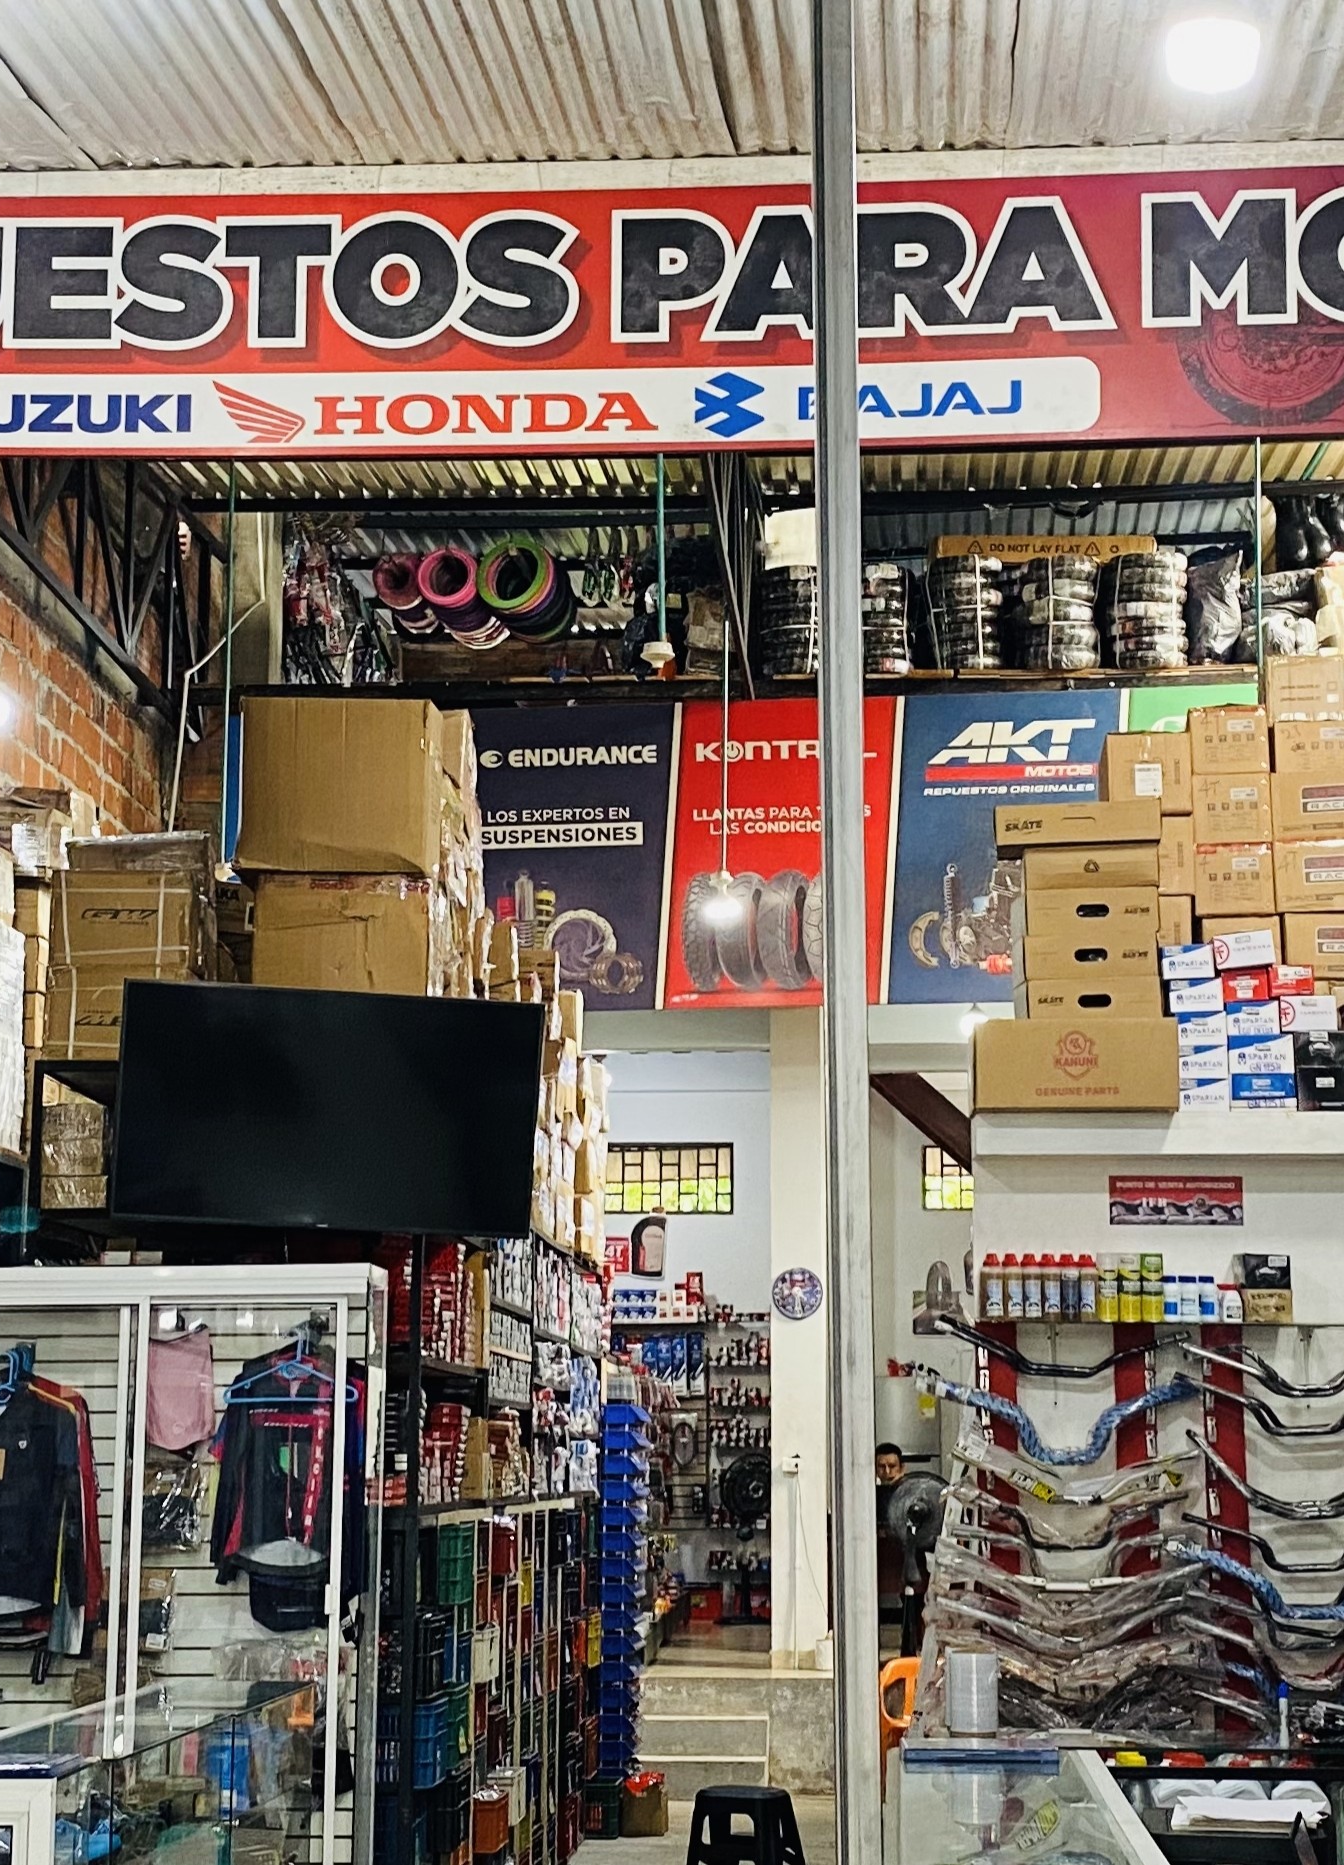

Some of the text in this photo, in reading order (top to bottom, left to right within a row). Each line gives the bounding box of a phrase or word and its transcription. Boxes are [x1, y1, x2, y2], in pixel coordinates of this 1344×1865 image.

[612, 195, 1116, 344] PARA
[314, 391, 658, 436] HONDA
[989, 543, 1081, 555] DO NOT LAY FLAT
[928, 718, 1096, 765] AKT
[508, 744, 658, 768] ENDURANCE
[695, 740, 878, 762] KONTR
[1024, 764, 1094, 777] MOTOS
[924, 783, 1096, 797] REPUESTOS ORIGINALES
[487, 807, 630, 824] LOS EXPERTOS EN
[692, 807, 765, 821] LLANTAS
[769, 805, 813, 820] PARA
[481, 826, 637, 845] SUSPENSIONES
[710, 821, 822, 836] LAS CONDICIO
[1248, 1052, 1287, 1061] SPARTAN
